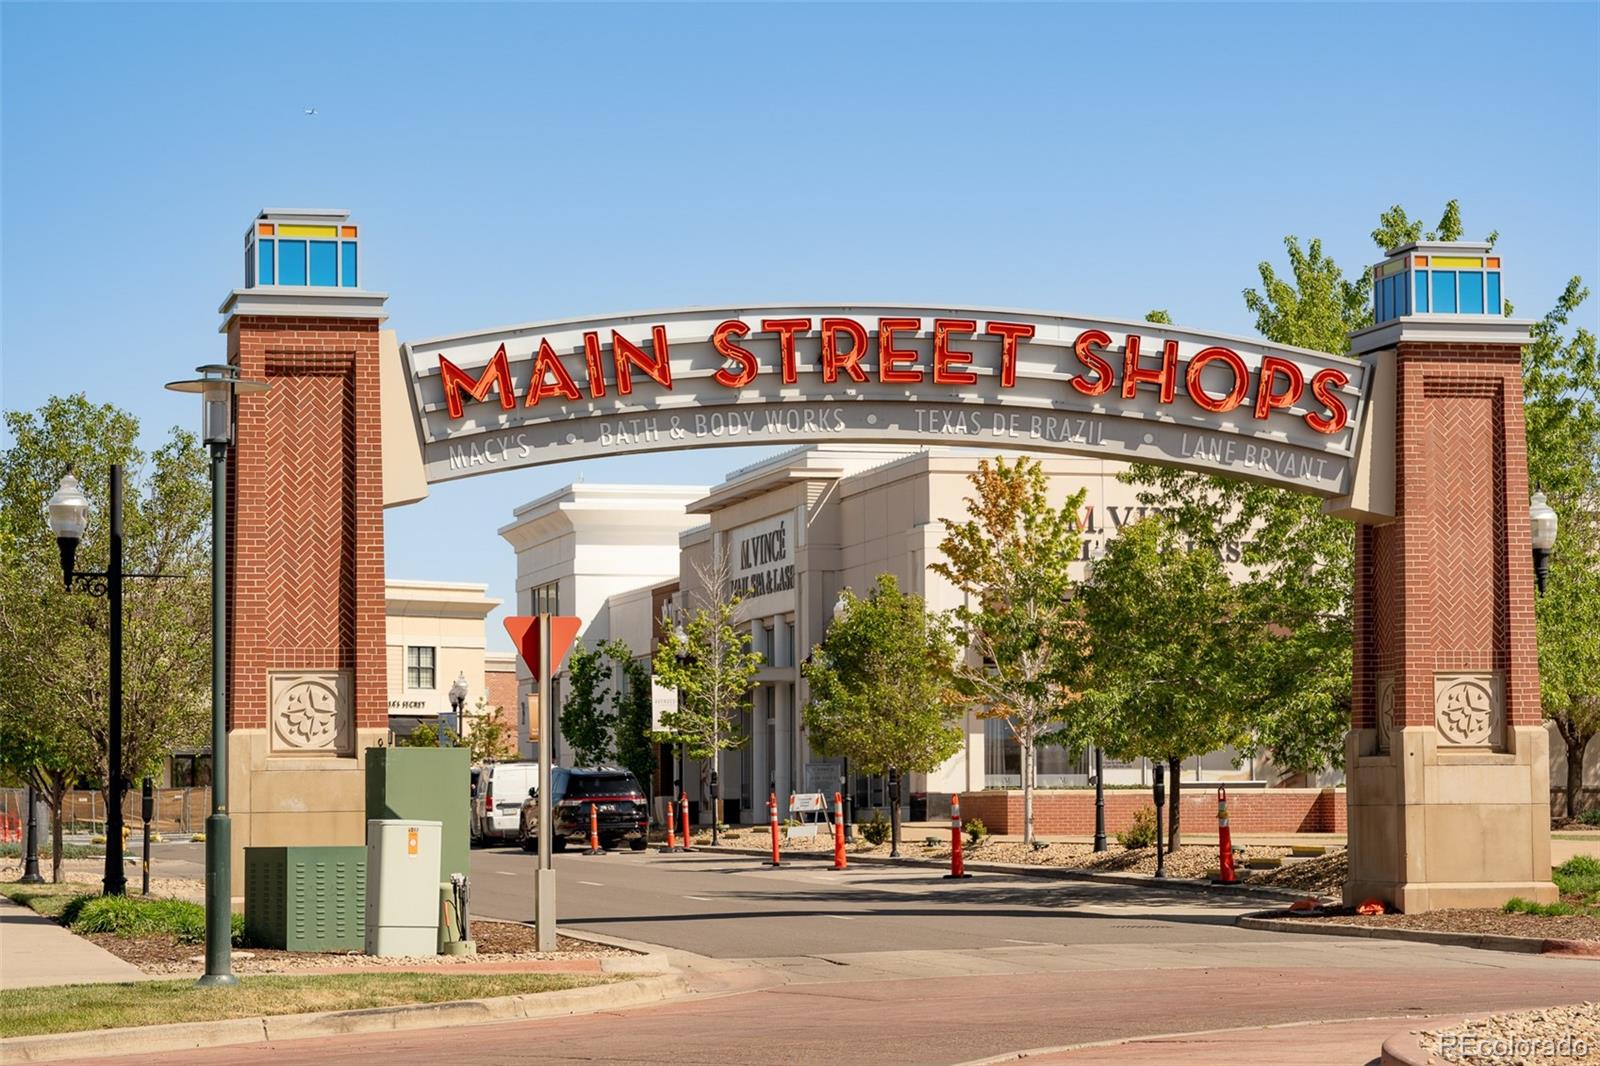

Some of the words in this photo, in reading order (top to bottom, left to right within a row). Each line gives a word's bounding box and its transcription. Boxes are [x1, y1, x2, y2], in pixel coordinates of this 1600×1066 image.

[438, 325, 673, 421] MAIN
[712, 317, 1036, 389] STREET
[1069, 329, 1350, 434] SHOPS
[600, 417, 659, 446] BATH
[670, 415, 685, 440] &
[695, 410, 754, 437] BODY
[765, 408, 845, 434] WORKS
[915, 409, 981, 435] TEXAS
[991, 412, 1020, 437] DE
[1029, 415, 1107, 446] BRAZIL
[449, 433, 530, 470] MACY'S
[1181, 433, 1236, 464] LANE
[1244, 444, 1328, 482] BRYANT
[751, 520, 786, 567] VINCÉ
